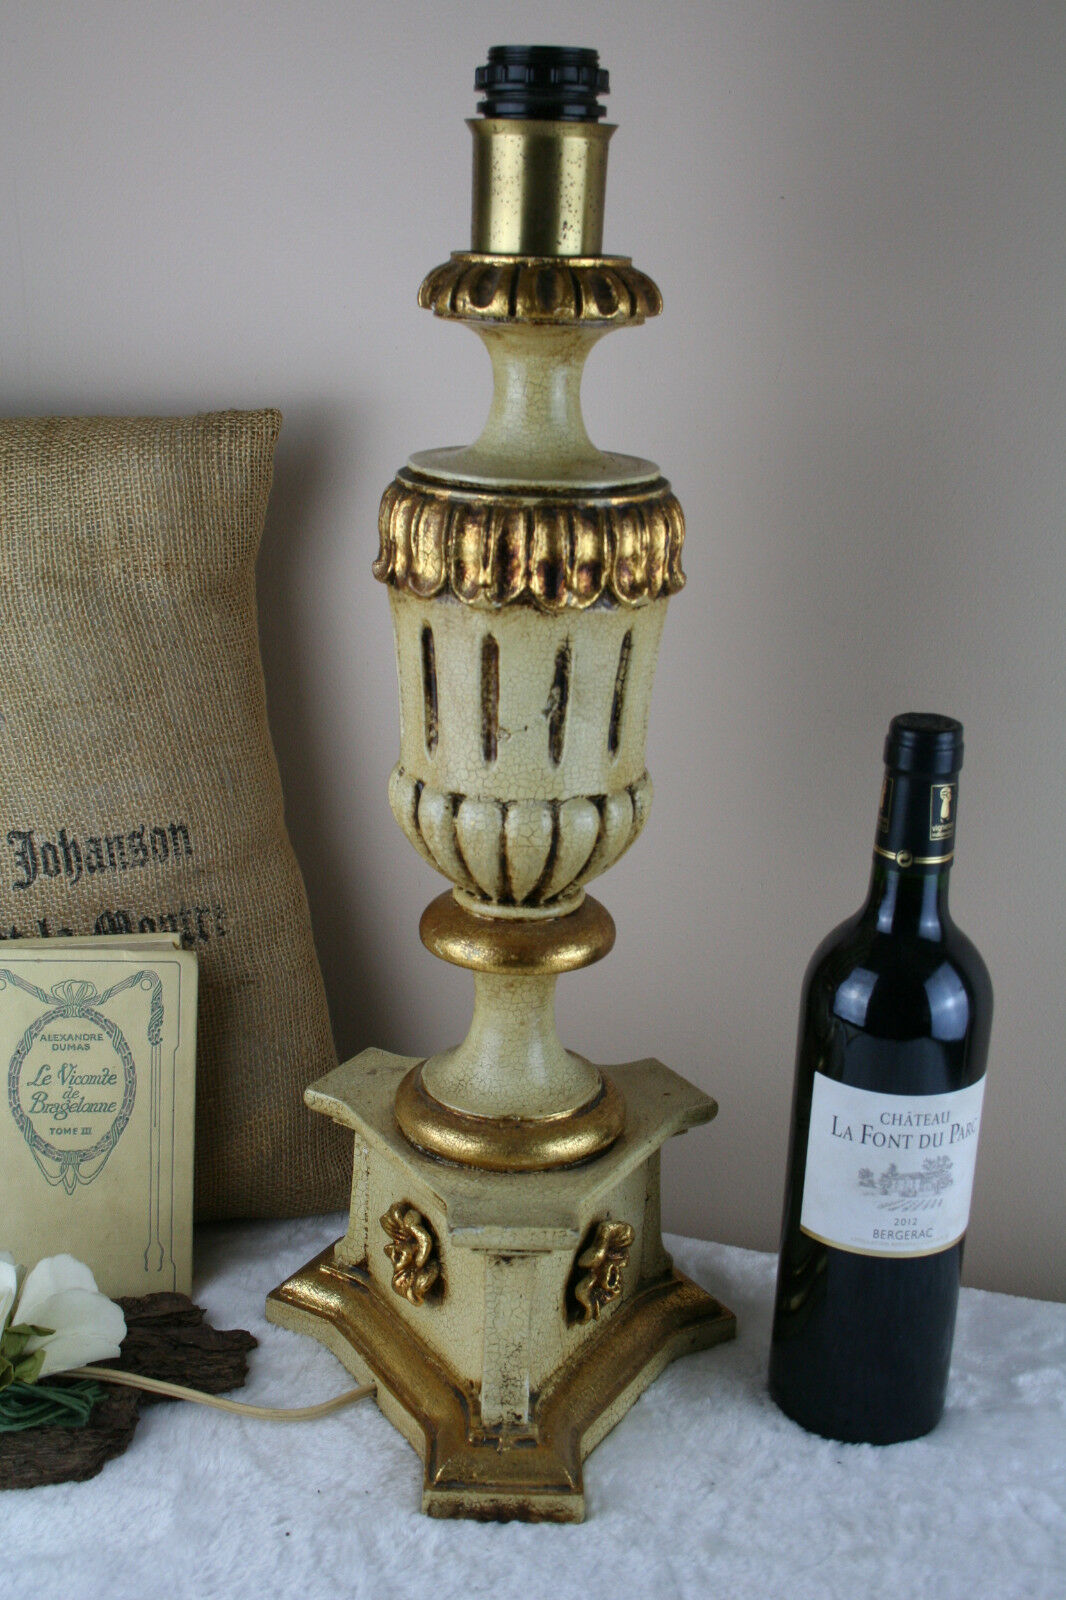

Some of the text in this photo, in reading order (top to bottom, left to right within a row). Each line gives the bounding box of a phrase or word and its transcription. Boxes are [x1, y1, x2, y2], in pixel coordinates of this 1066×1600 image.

[7, 823, 193, 890] Johanson
[39, 1033, 104, 1042] ALEXANDRE
[51, 1043, 91, 1052] DUMAS
[27, 1062, 118, 1087] Le Vicomte
[62, 1086, 80, 1100] de
[28, 1090, 118, 1121] Bragelonne
[880, 1110, 951, 1127] CHÂTEAU
[50, 1126, 93, 1136] TOME III
[831, 1114, 853, 1142] LA
[860, 1123, 913, 1150] FONT
[918, 1131, 944, 1149] DU
[894, 1217, 918, 1227] 2012
[872, 1227, 935, 1241] BERGERAC
